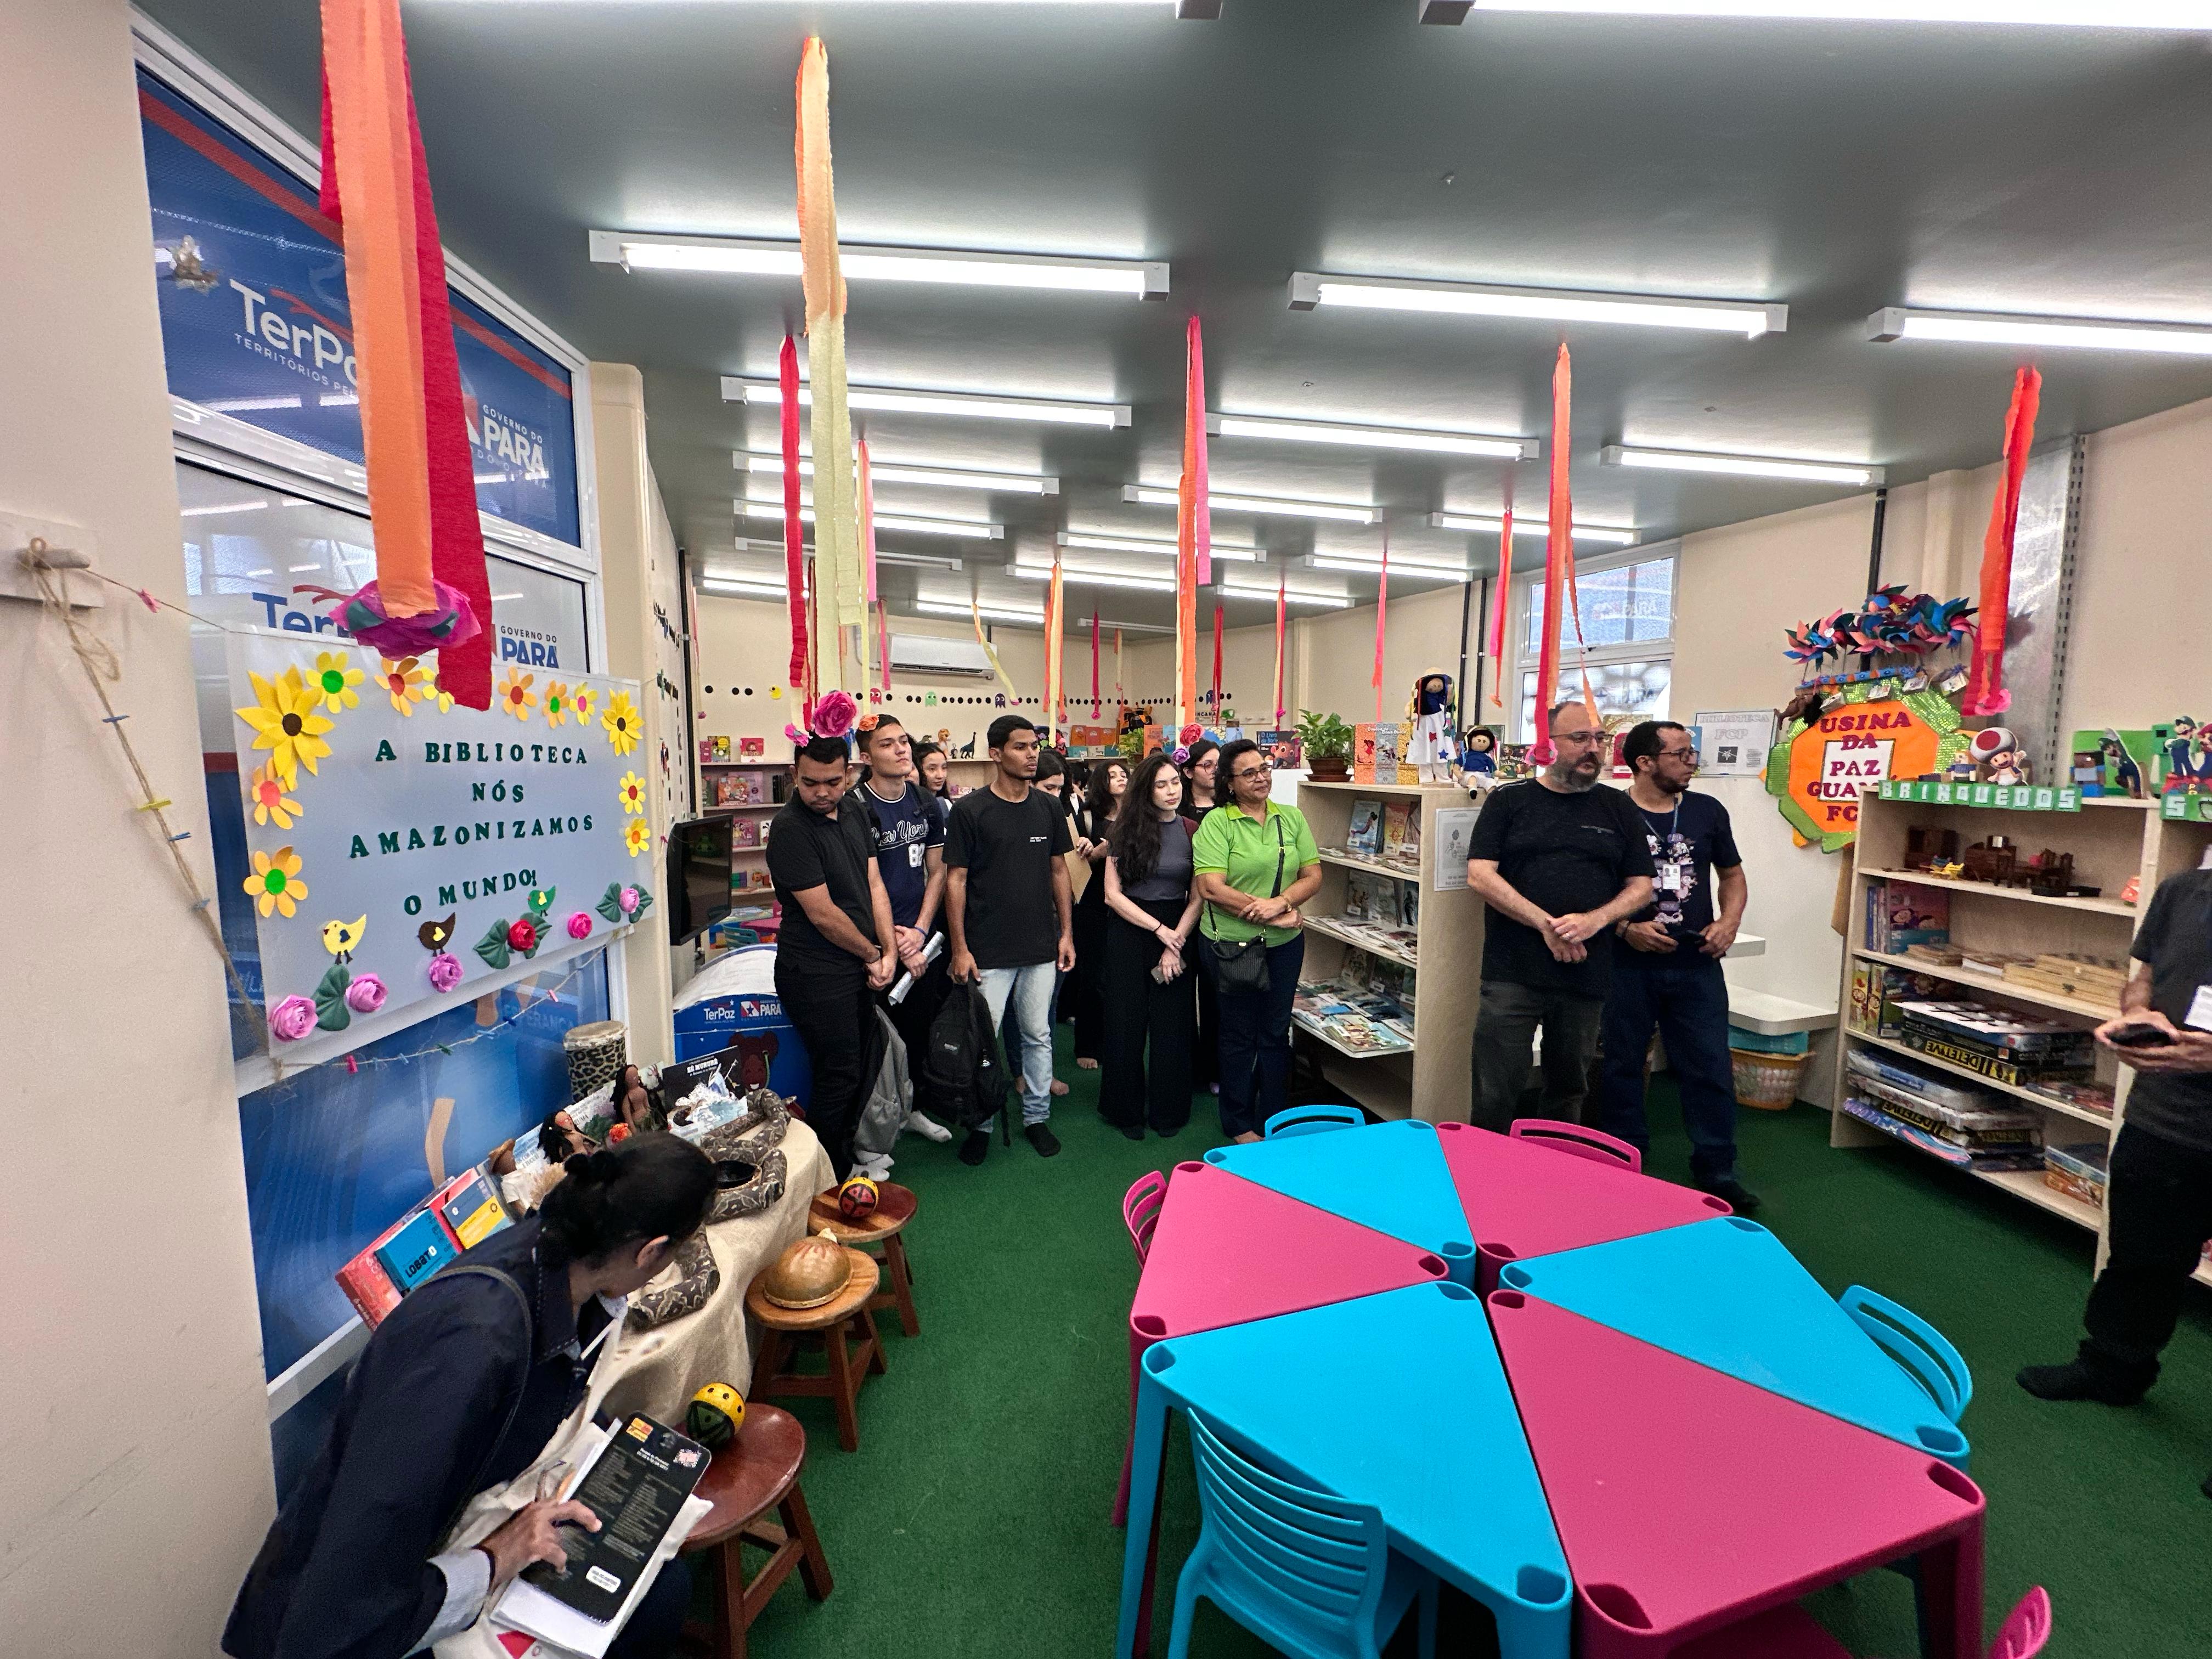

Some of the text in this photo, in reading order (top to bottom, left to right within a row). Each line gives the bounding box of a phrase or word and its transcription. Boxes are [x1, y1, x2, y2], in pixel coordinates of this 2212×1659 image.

[229, 278, 358, 387] TerP
[234, 332, 357, 399] TERRITÓRIOS PEL
[483, 404, 543, 444] GOVERNO DO
[500, 625, 557, 643] GOVERNO DO
[1700, 714, 1770, 724] BIBLIOTECA
[1820, 711, 1912, 733] USINA
[1715, 729, 1748, 740] FCP
[1841, 732, 1878, 751] DA
[375, 740, 588, 764] A BIBLIOTECA
[1829, 760, 1881, 776] PAZ
[472, 779, 524, 803] NÓS
[1807, 781, 1878, 798] GUA
[1881, 781, 2076, 809] BRINQUEDOS
[1826, 805, 1859, 822] FC
[349, 814, 594, 859] AMAZONIZAMOS
[871, 819, 930, 845] New York
[403, 868, 538, 916] O MUNDO!
[703, 1007, 736, 1020] TerPaz
[1926, 1040, 1979, 1069] DETETIVE
